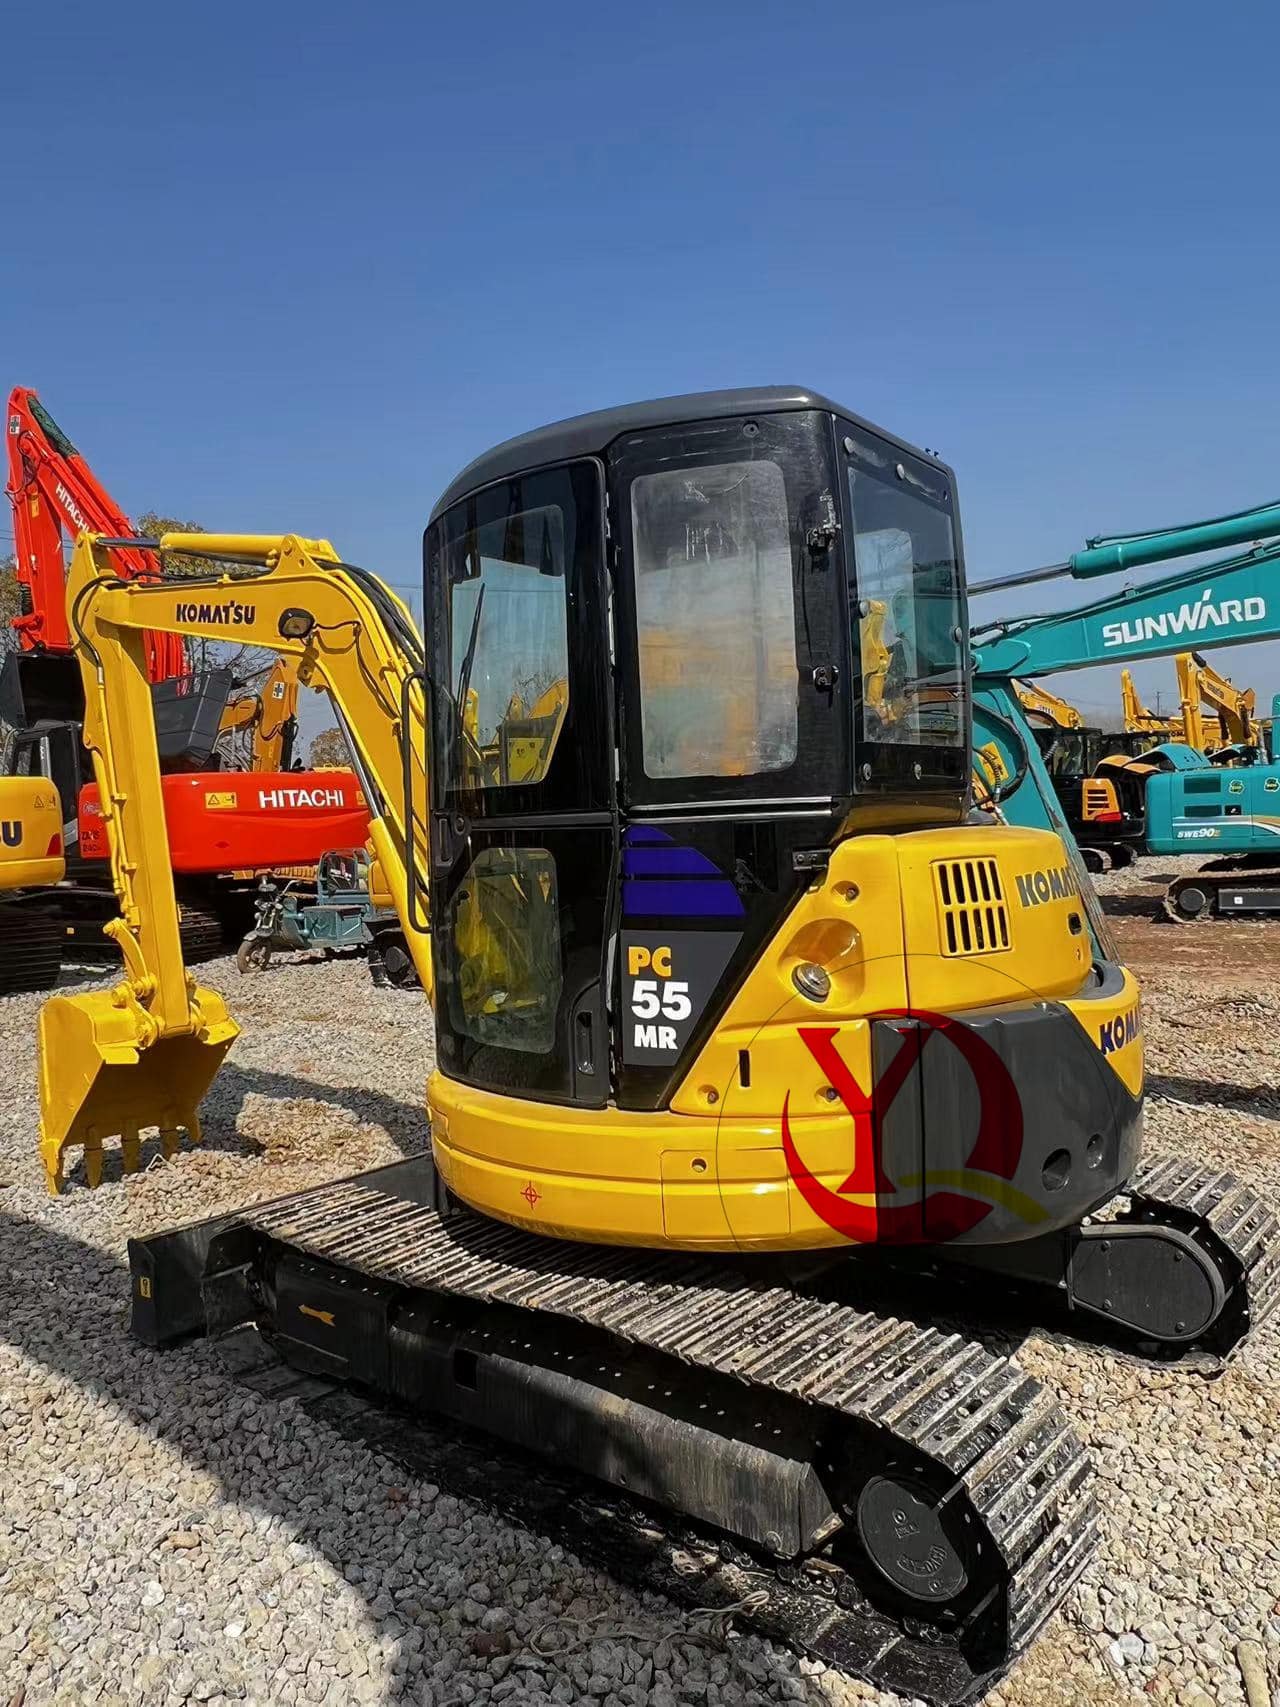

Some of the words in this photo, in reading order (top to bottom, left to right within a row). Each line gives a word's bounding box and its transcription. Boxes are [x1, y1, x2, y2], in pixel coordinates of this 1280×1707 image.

[55, 482, 90, 532] HITACHI
[176, 600, 256, 625] KOMATSU
[1102, 589, 1266, 647] SUNWARD
[259, 788, 344, 809] HITACHI
[628, 946, 672, 978] PC
[631, 980, 692, 1021] 55
[634, 1024, 679, 1050] MR
